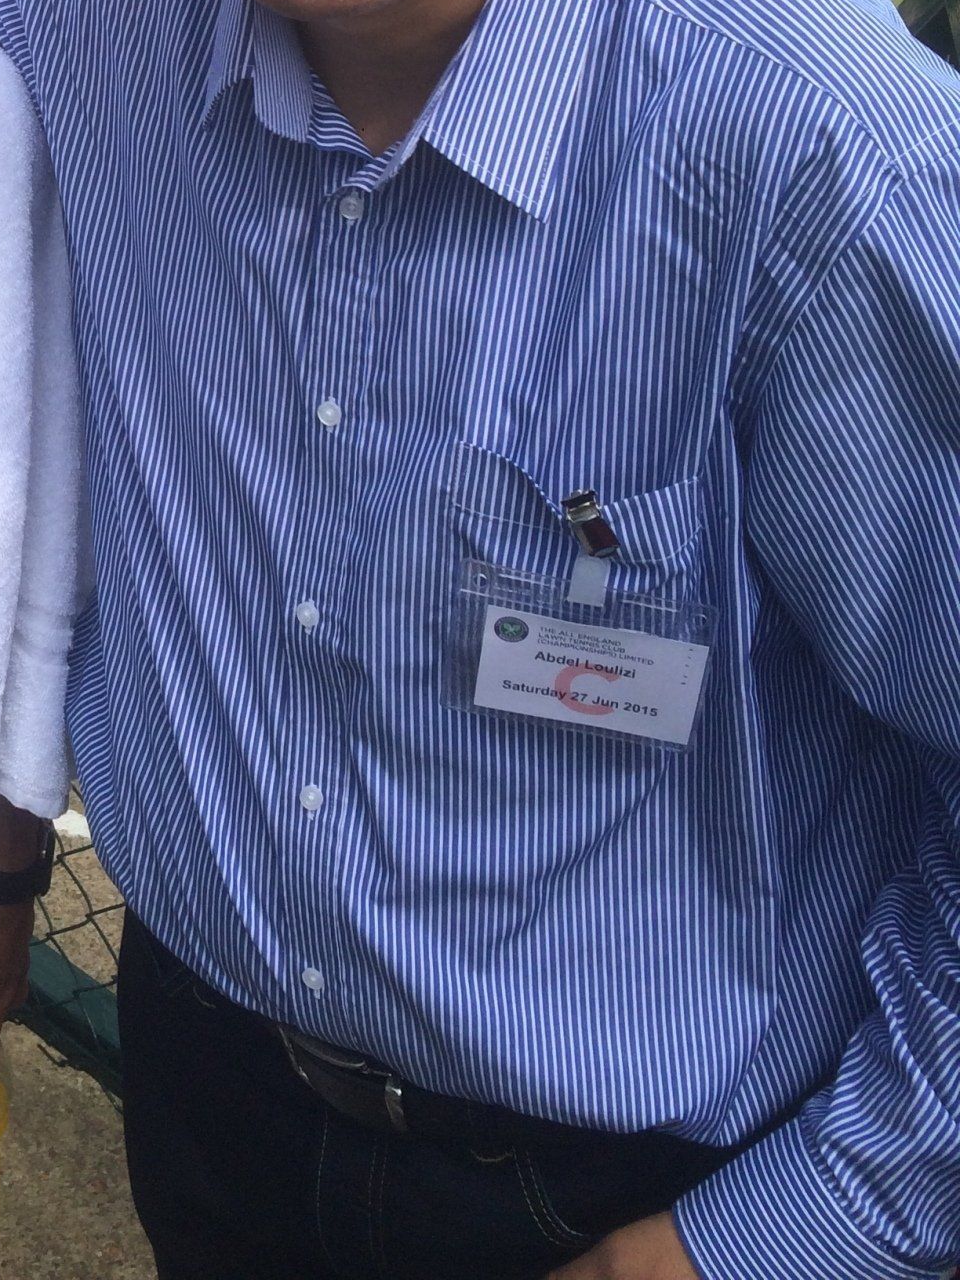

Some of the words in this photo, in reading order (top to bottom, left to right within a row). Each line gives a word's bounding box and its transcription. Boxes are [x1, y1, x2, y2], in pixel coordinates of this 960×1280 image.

[538, 633, 566, 643] LAWN
[569, 637, 600, 648] TENNIS
[602, 644, 626, 654] CLUB
[577, 633, 622, 646] ENGLAND
[534, 650, 580, 668] Abdel
[584, 659, 637, 679] Loulizi
[618, 653, 654, 666] LIMITED
[502, 679, 568, 701] Saturday
[570, 691, 588, 703] 27
[592, 696, 619, 709] Jun
[623, 702, 659, 718] 2015
